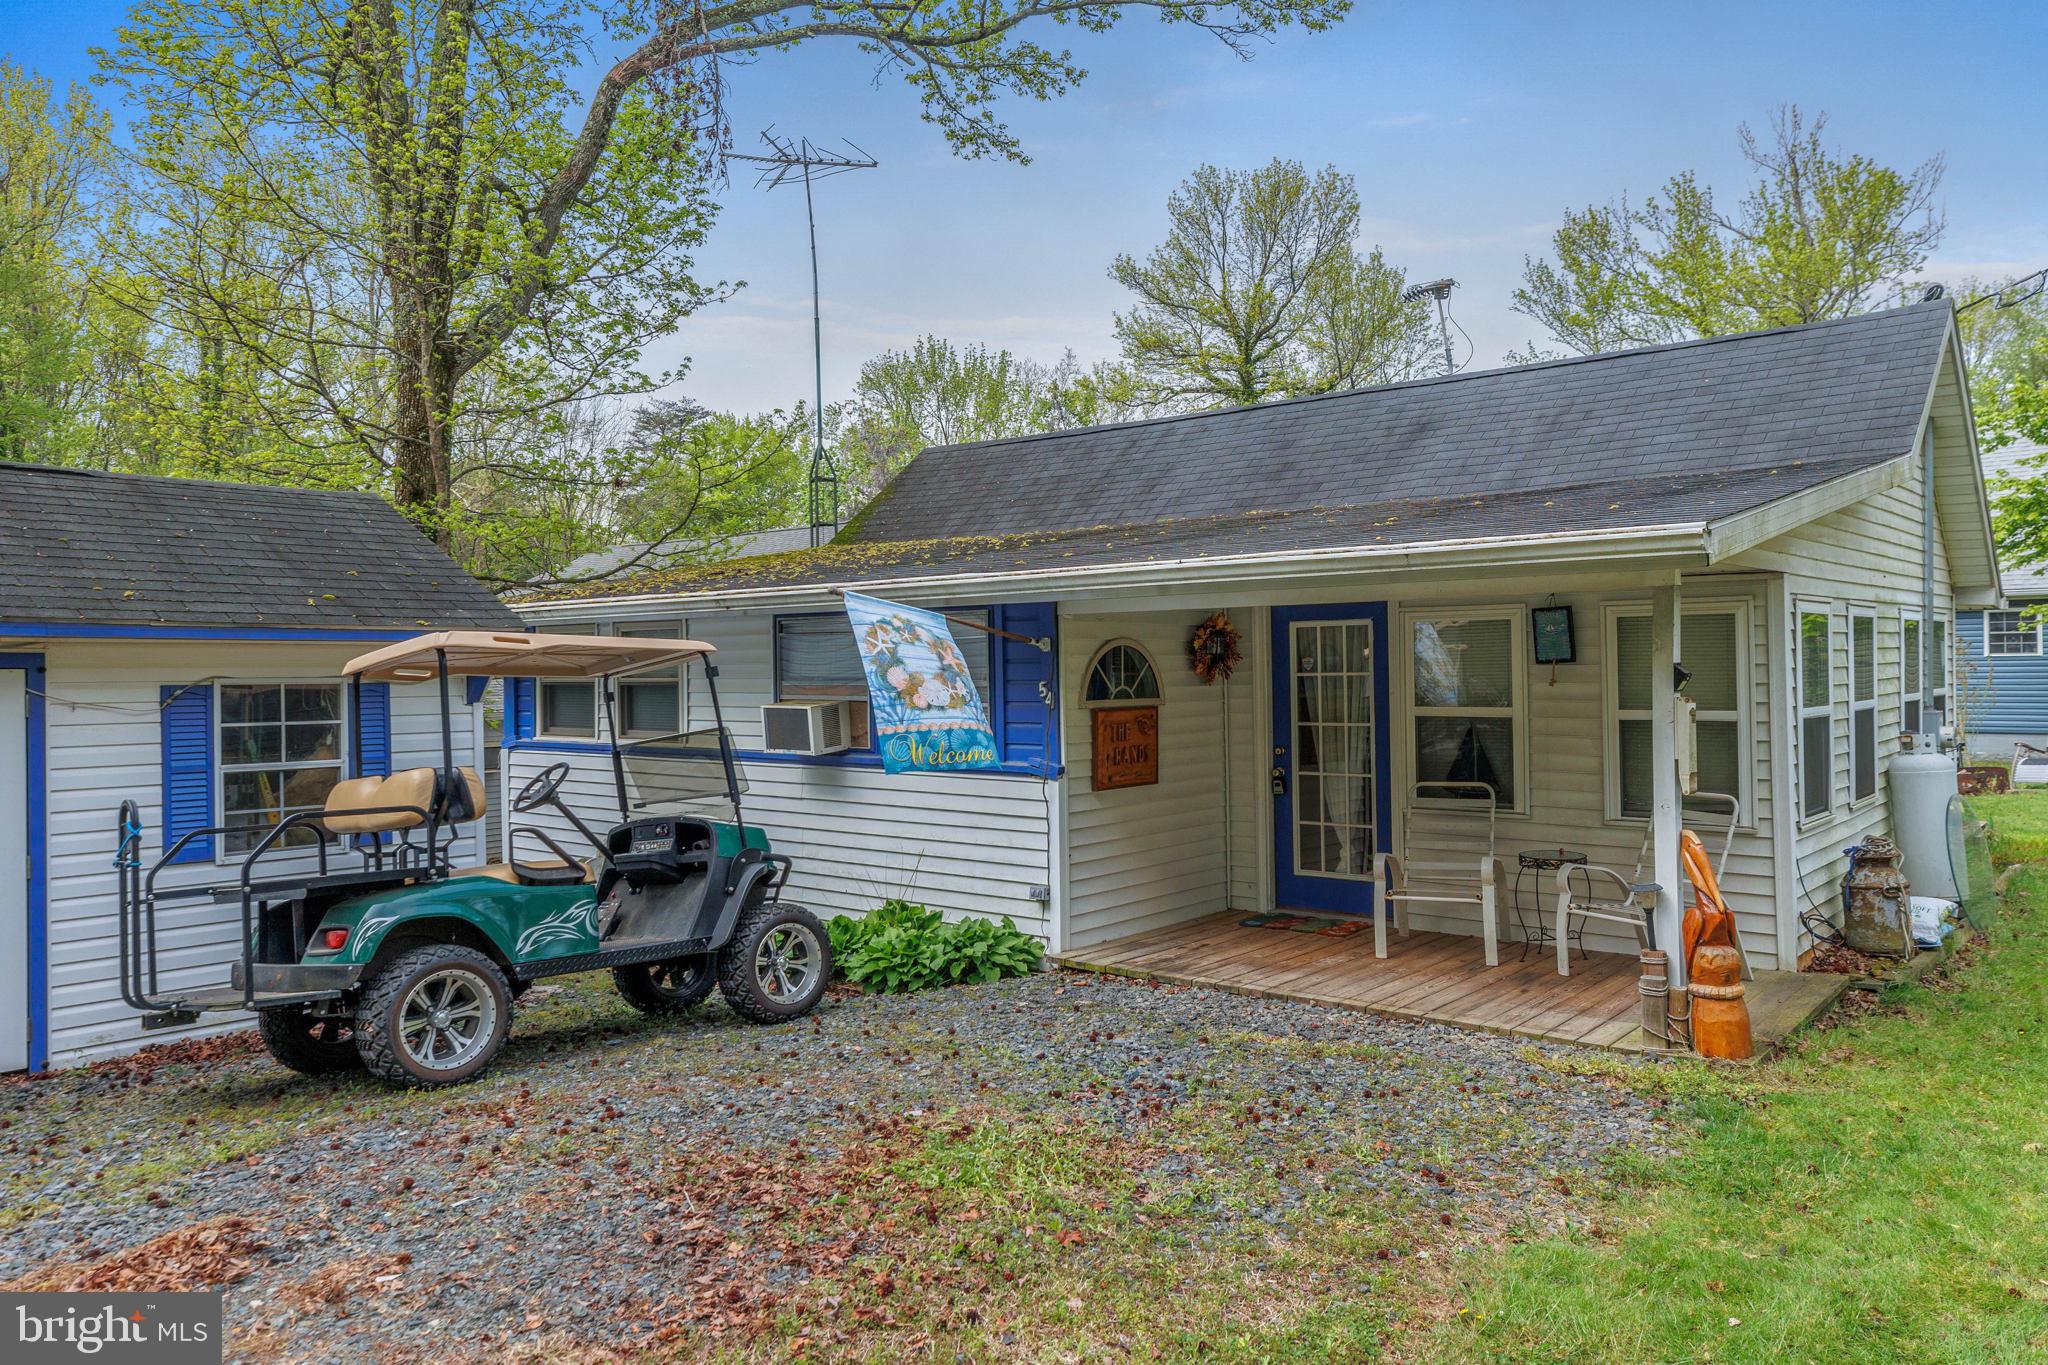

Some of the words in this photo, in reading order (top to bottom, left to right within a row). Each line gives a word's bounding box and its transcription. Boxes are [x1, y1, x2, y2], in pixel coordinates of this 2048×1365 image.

[1038, 680, 1055, 710] 54
[1112, 722, 1132, 742] THE
[890, 733, 994, 766] Welcome
